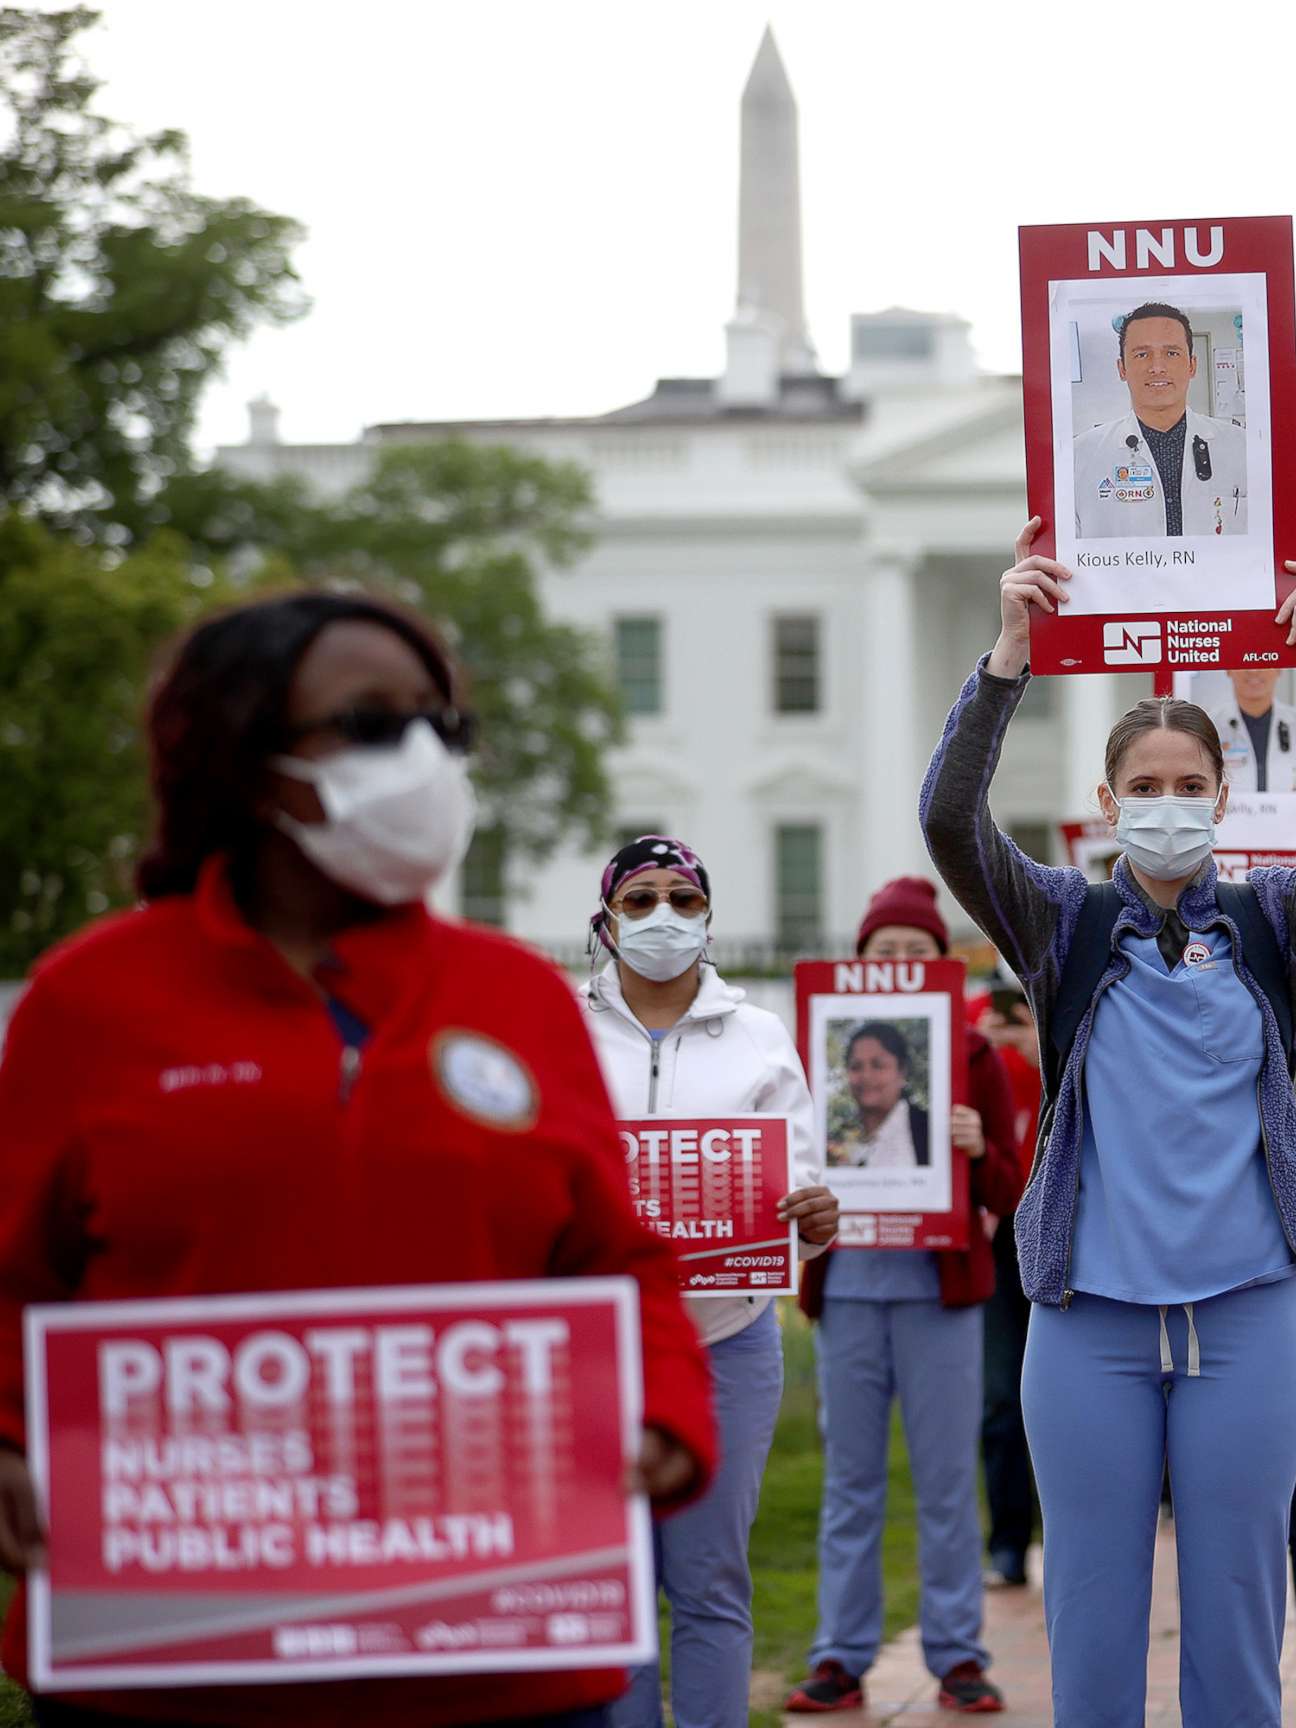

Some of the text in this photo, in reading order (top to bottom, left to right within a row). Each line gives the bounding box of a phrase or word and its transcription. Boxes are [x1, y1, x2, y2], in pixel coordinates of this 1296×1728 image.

[1087, 225, 1225, 271] NNU
[1077, 551, 1195, 568] Kious Kelly, RN
[1167, 619, 1232, 633] National
[1168, 635, 1220, 649] Nurses
[1168, 649, 1220, 663] United
[1242, 652, 1279, 662] AFL-CIO
[834, 963, 925, 993] NNU
[652, 1219, 733, 1238] EALTH
[724, 1256, 785, 1267] #COVID19
[100, 1318, 570, 1417] PROTECT
[104, 1430, 312, 1478] NURSES
[105, 1474, 357, 1525] PATIENTS
[105, 1512, 514, 1574] PUBLIC HEALTH
